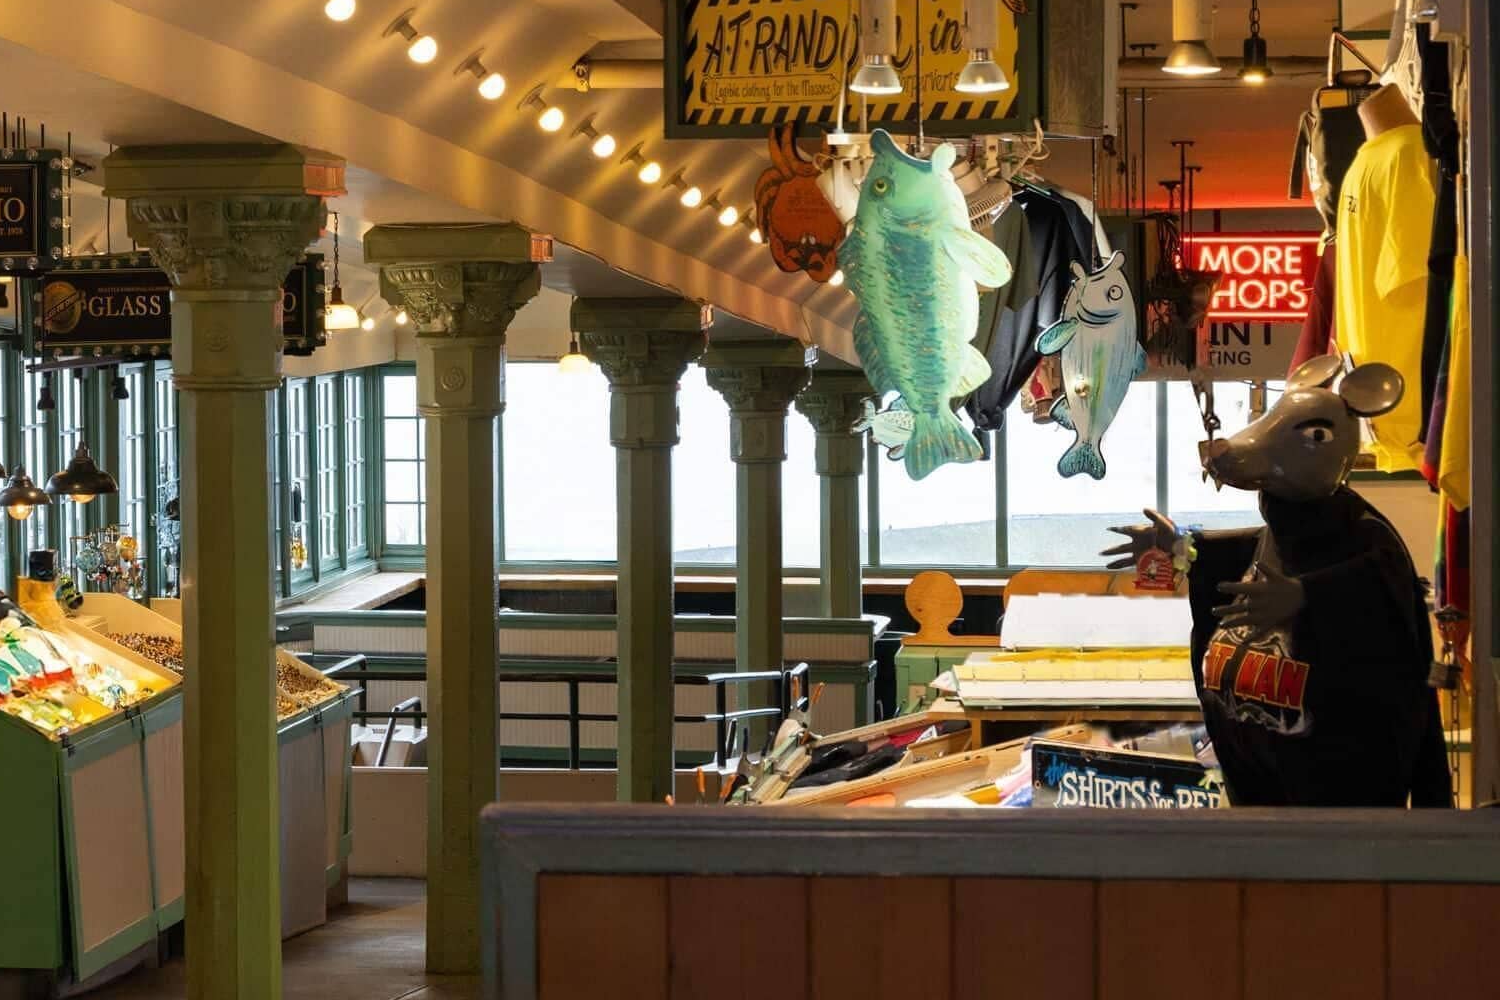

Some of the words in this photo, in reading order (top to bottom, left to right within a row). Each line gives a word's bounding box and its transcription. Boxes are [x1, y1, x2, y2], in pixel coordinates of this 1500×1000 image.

[1200, 245, 1302, 275] MORE
[88, 296, 162, 317] GLASS
[1211, 279, 1309, 310] HOPS
[1235, 650, 1310, 710] MAN
[1056, 770, 1147, 808] SHIRTS
